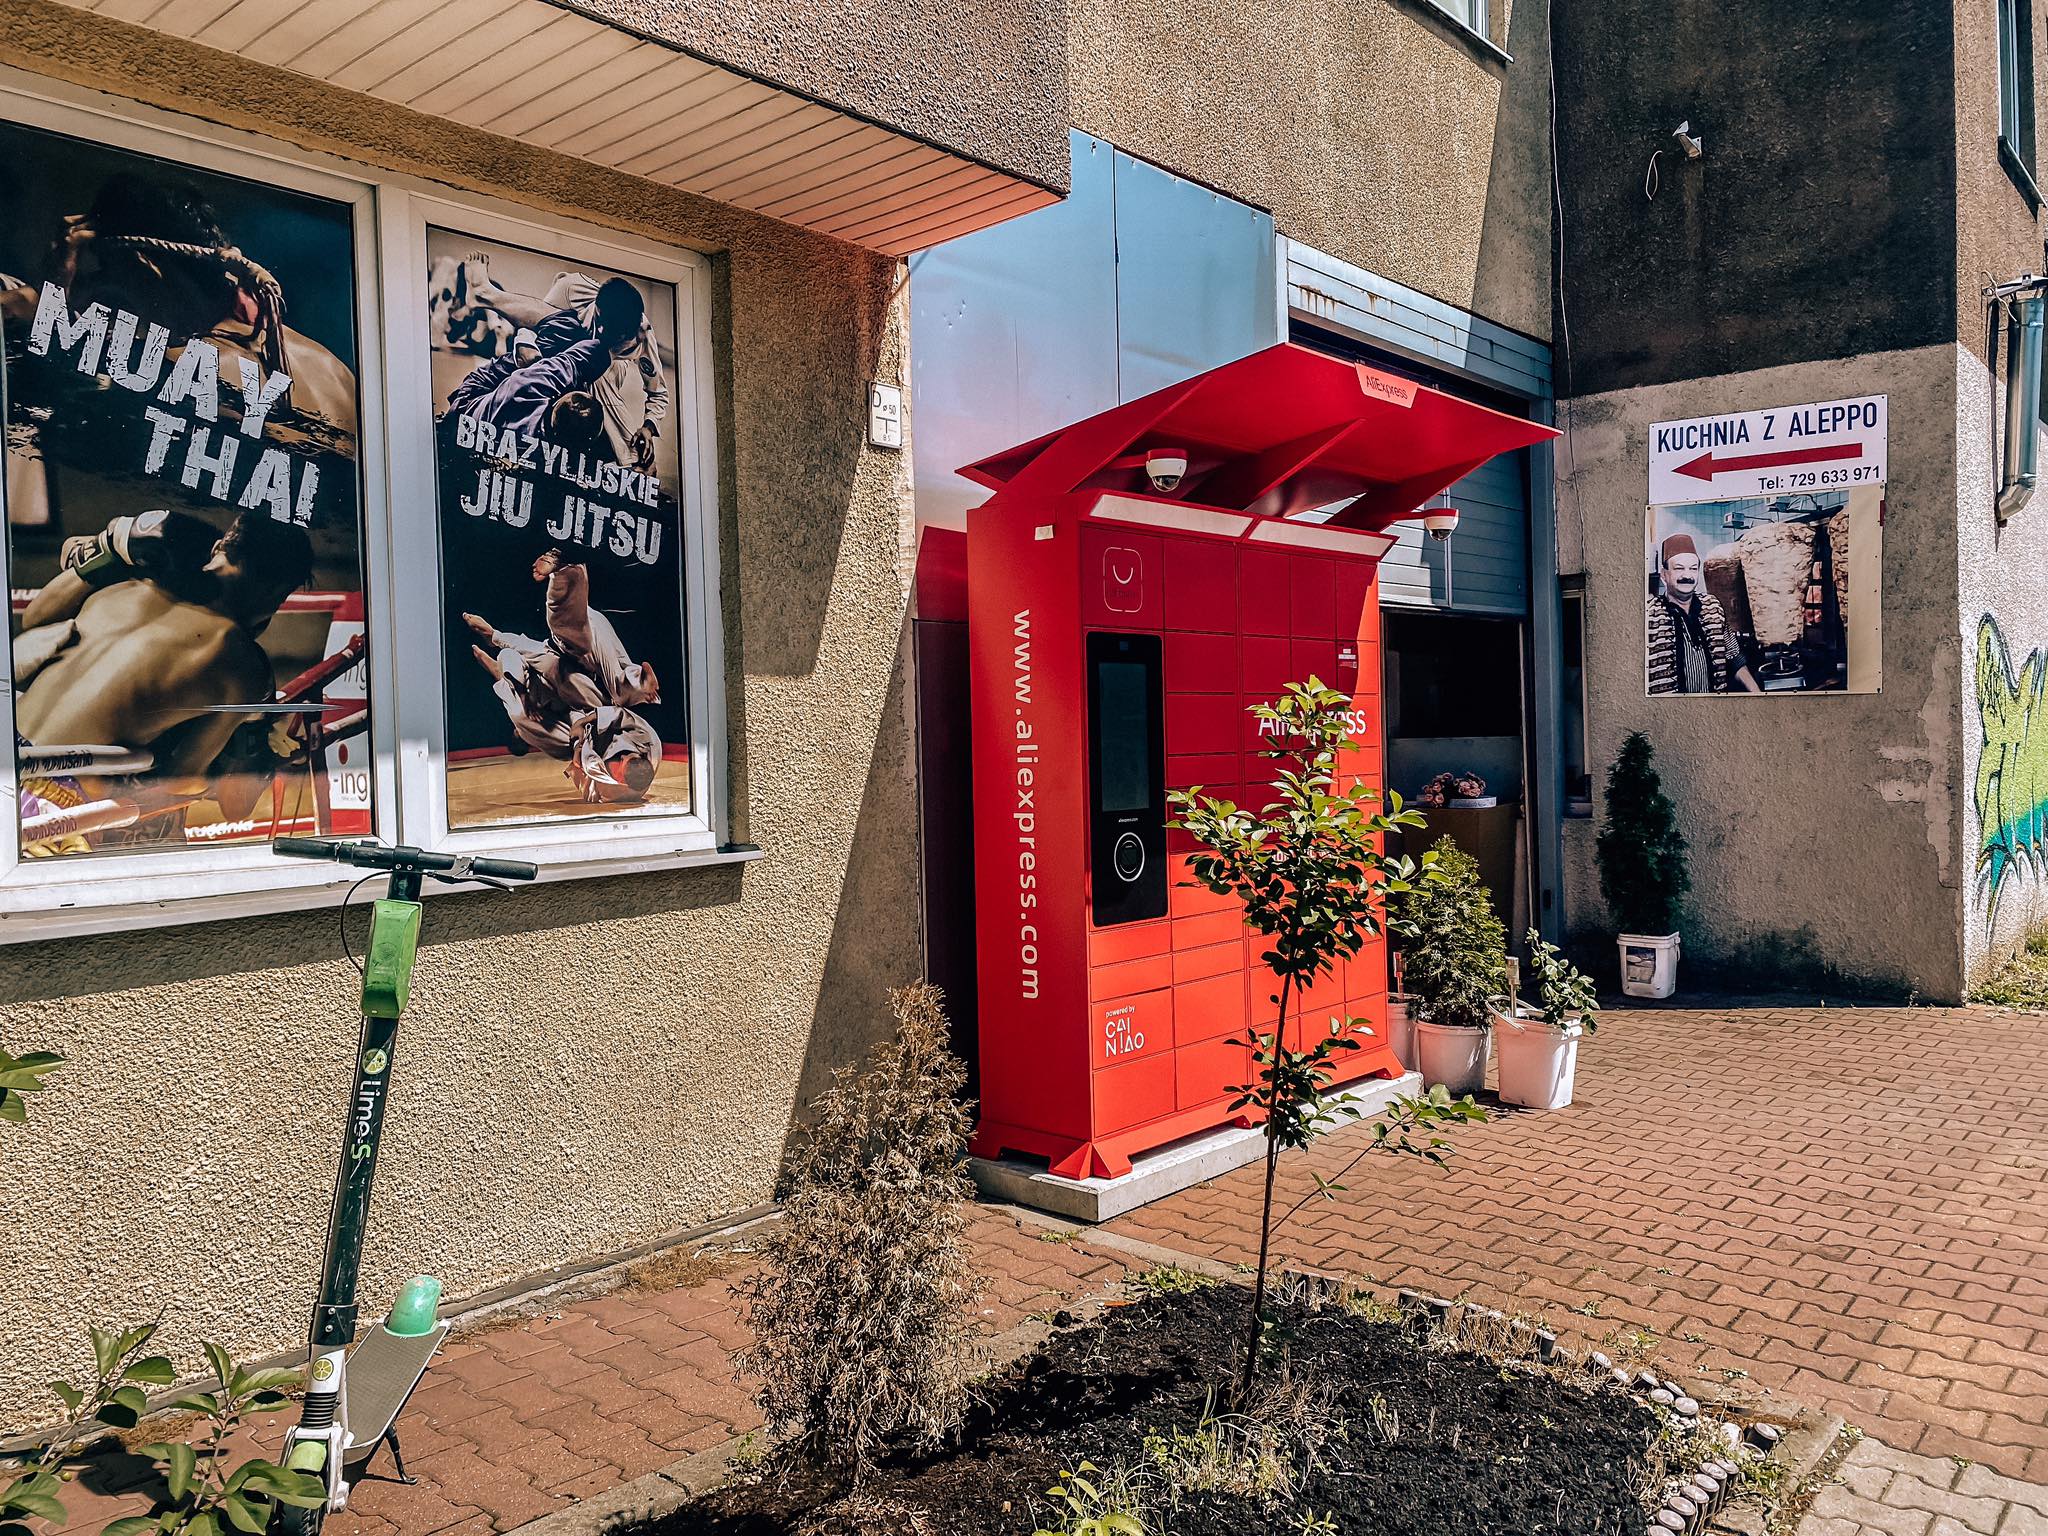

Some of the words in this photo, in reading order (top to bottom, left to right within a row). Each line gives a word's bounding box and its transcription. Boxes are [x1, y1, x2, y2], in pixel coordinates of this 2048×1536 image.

[28, 281, 292, 439] MUAY
[1366, 375, 1408, 400] AliExpress
[144, 406, 320, 529] THAI
[456, 414, 661, 508] BRAZYLIJSKIE
[1657, 419, 1750, 453] KUCHNIA
[1763, 415, 1776, 441] Z
[1788, 402, 1878, 438] ALEPPO
[460, 468, 534, 528] JIU
[546, 495, 662, 565] JITSU
[1757, 478, 1784, 490] Tel:
[1789, 472, 1816, 487] 729
[1821, 469, 1848, 484] 633
[1853, 465, 1880, 480] 971
[1013, 609, 1040, 1000] www.aliexpress.com
[1105, 1006, 1128, 1018] powered
[1128, 1005, 1136, 1013] by
